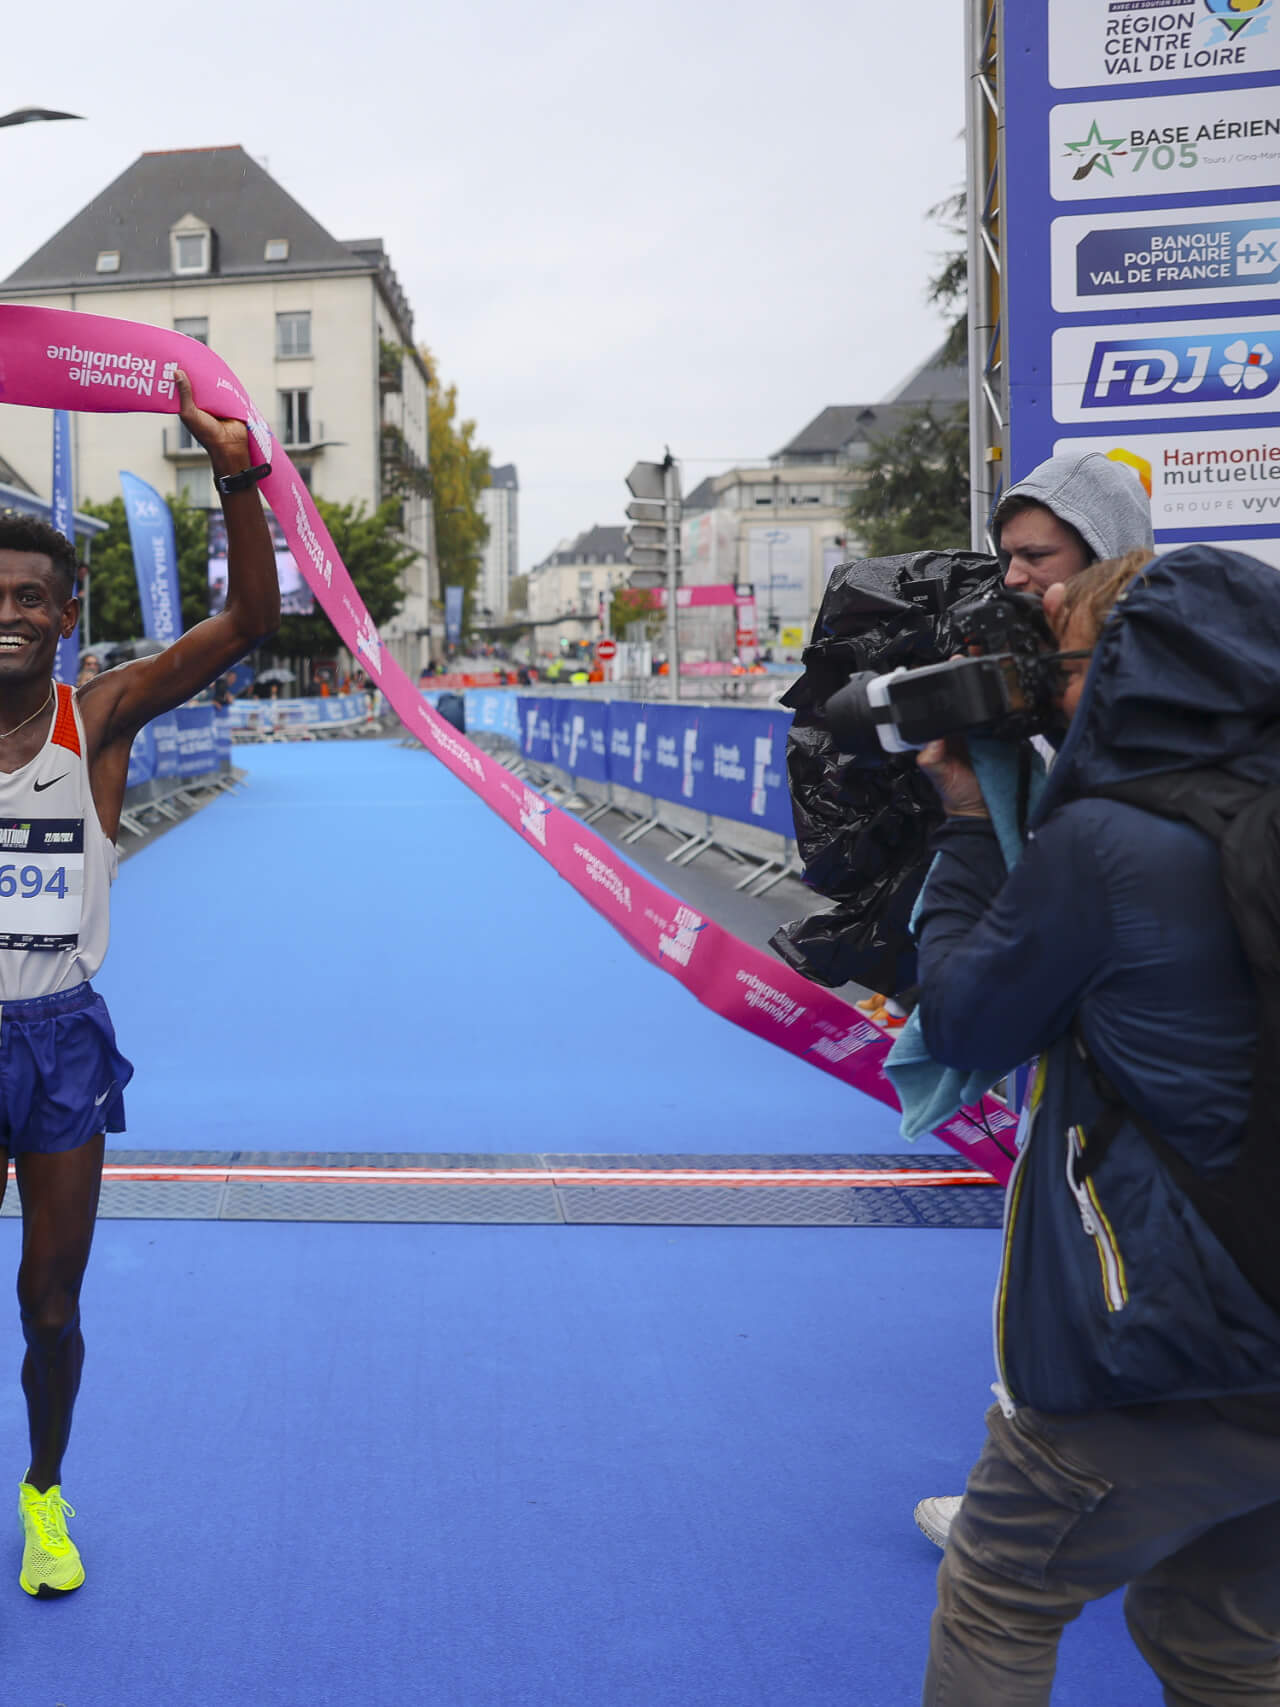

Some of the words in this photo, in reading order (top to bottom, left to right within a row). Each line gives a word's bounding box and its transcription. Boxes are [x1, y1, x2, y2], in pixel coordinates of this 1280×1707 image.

[1106, 12, 1195, 36] RÉGION
[1105, 32, 1192, 55] CENTRE
[1104, 57, 1142, 75] VAL
[1149, 53, 1177, 71] DE
[1183, 47, 1246, 68] LOIRE
[1130, 126, 1189, 146] BASE
[1130, 143, 1198, 172] 705
[1151, 232, 1231, 250] BANQUE
[1124, 246, 1231, 266] POPULAIRE
[1089, 271, 1124, 285] VAL
[1127, 269, 1152, 283] DE
[1156, 263, 1231, 281] FRANCE
[47, 345, 156, 378] République
[1094, 346, 1212, 398] FDJ
[69, 366, 153, 396] Nouvelle
[157, 380, 176, 400] la
[1163, 444, 1280, 466] Harmonie
[1164, 463, 1280, 485] mutuelle
[1163, 500, 1233, 513] GROUPE
[1242, 496, 1280, 513] vyv
